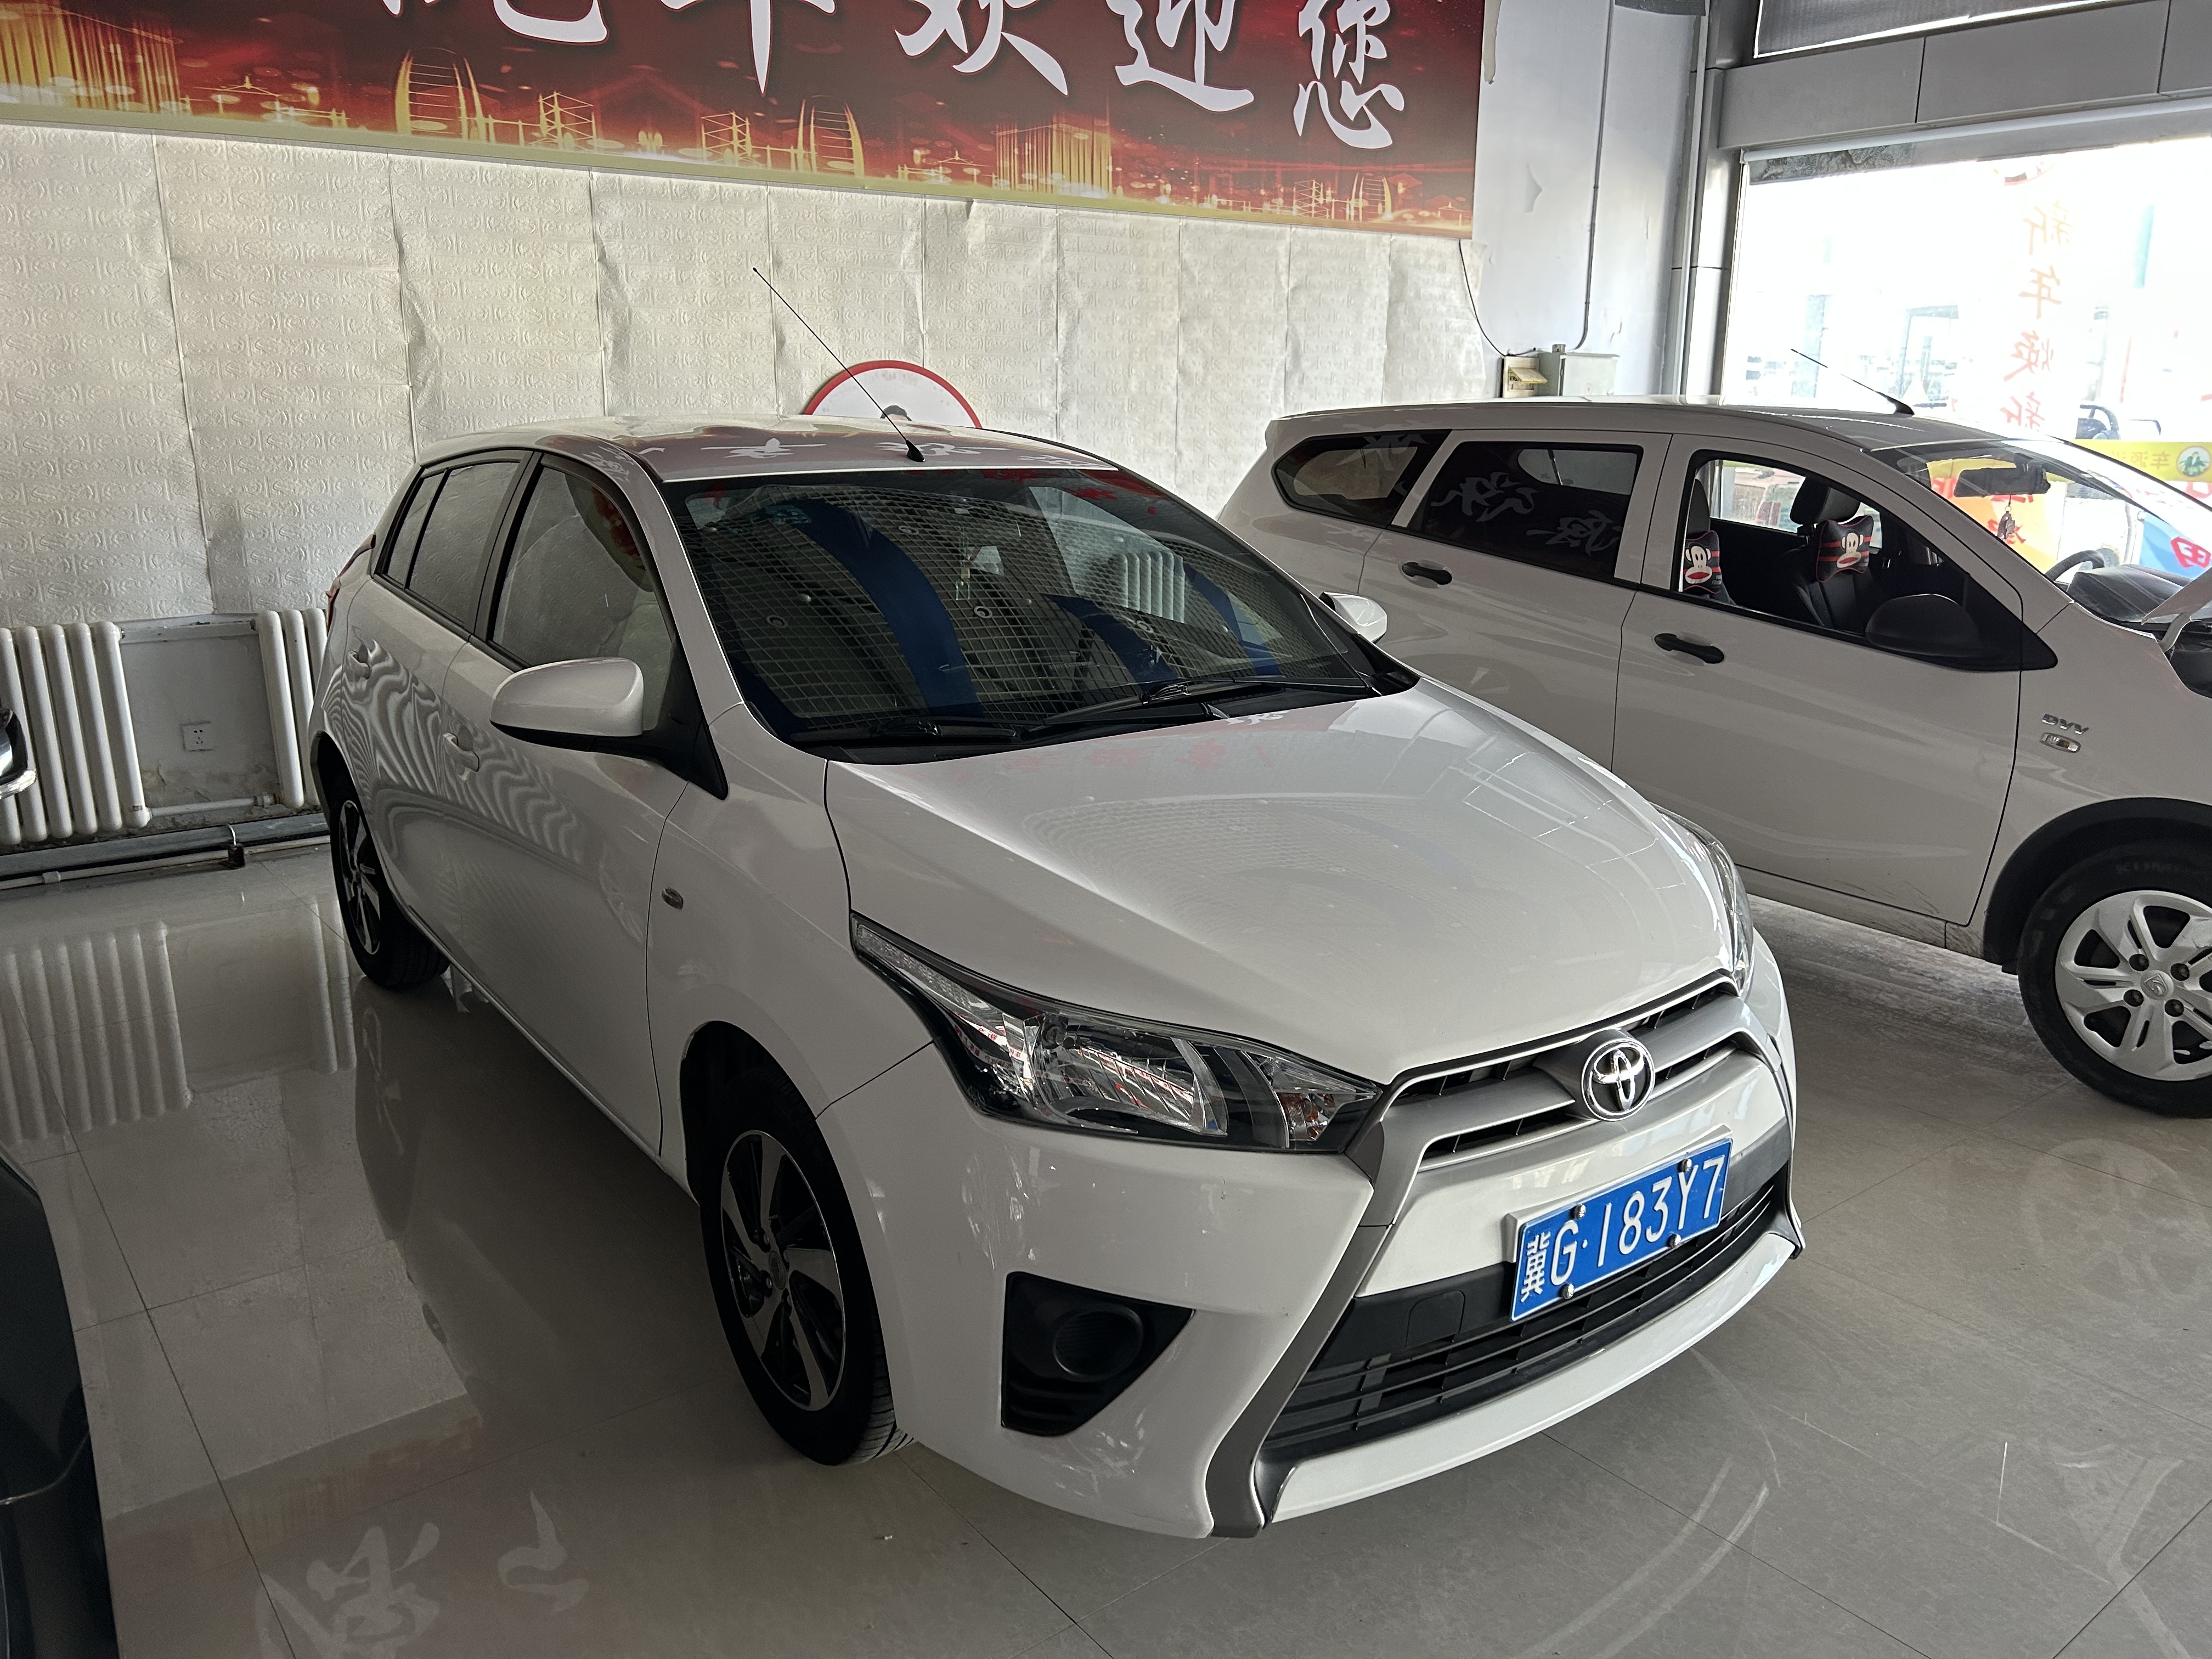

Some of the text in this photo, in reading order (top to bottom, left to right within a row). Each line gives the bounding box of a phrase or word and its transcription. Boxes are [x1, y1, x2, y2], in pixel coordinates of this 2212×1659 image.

[380, 0, 1404, 149] 欢迎您
[1520, 1154, 1725, 1302] 冀G·183Y7
